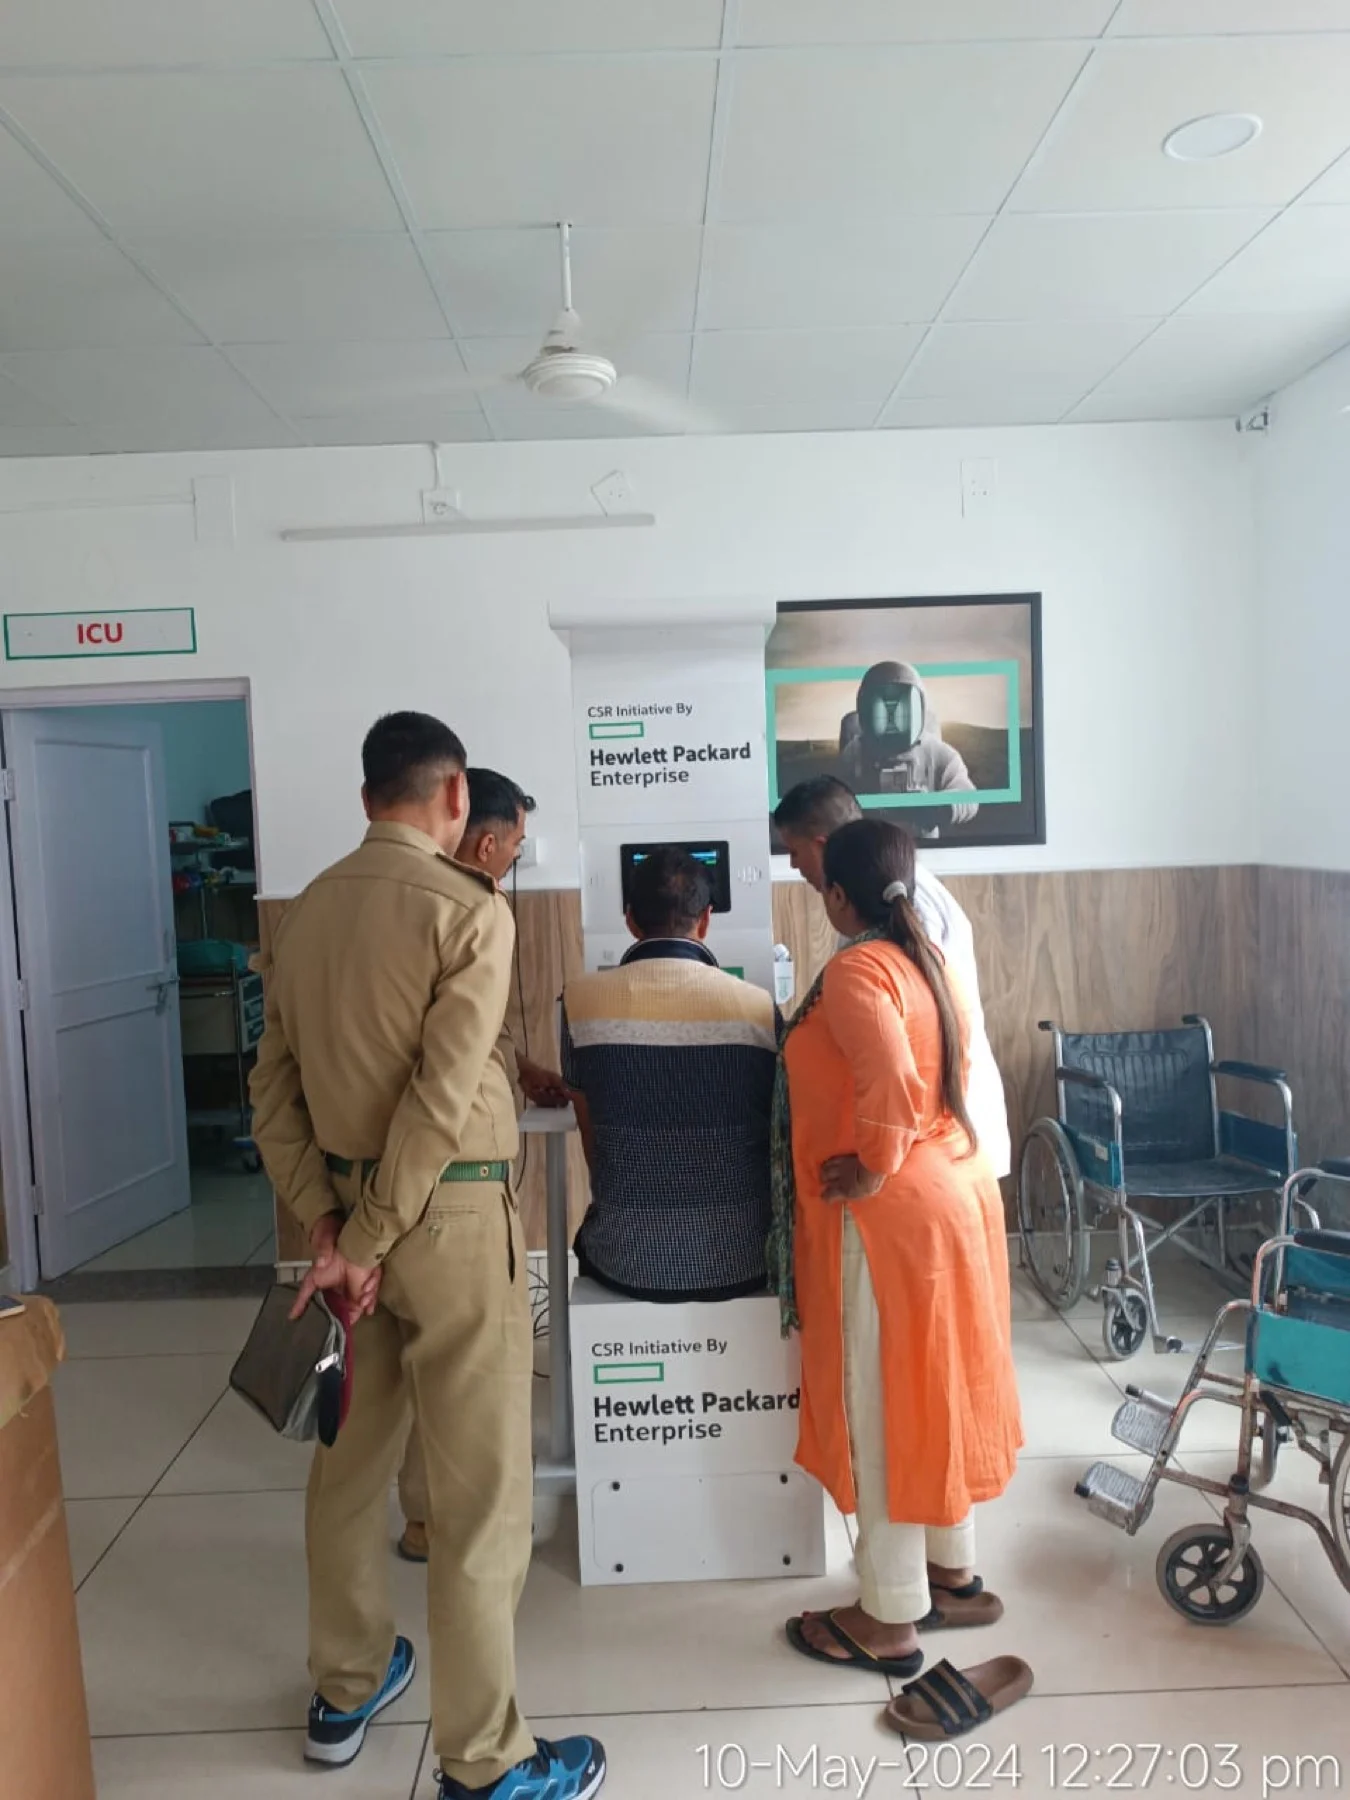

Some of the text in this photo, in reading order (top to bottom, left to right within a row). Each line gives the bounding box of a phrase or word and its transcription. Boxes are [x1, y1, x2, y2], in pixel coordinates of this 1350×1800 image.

[76, 622, 123, 645] ICU
[587, 702, 693, 718] CSR Initiative By
[590, 742, 751, 767] Hewlett Packard
[590, 767, 690, 789] Enterprise
[591, 1338, 728, 1358] CSR Initiative By
[593, 1388, 800, 1419] Hewlett Packard
[594, 1420, 723, 1446] Enterprise
